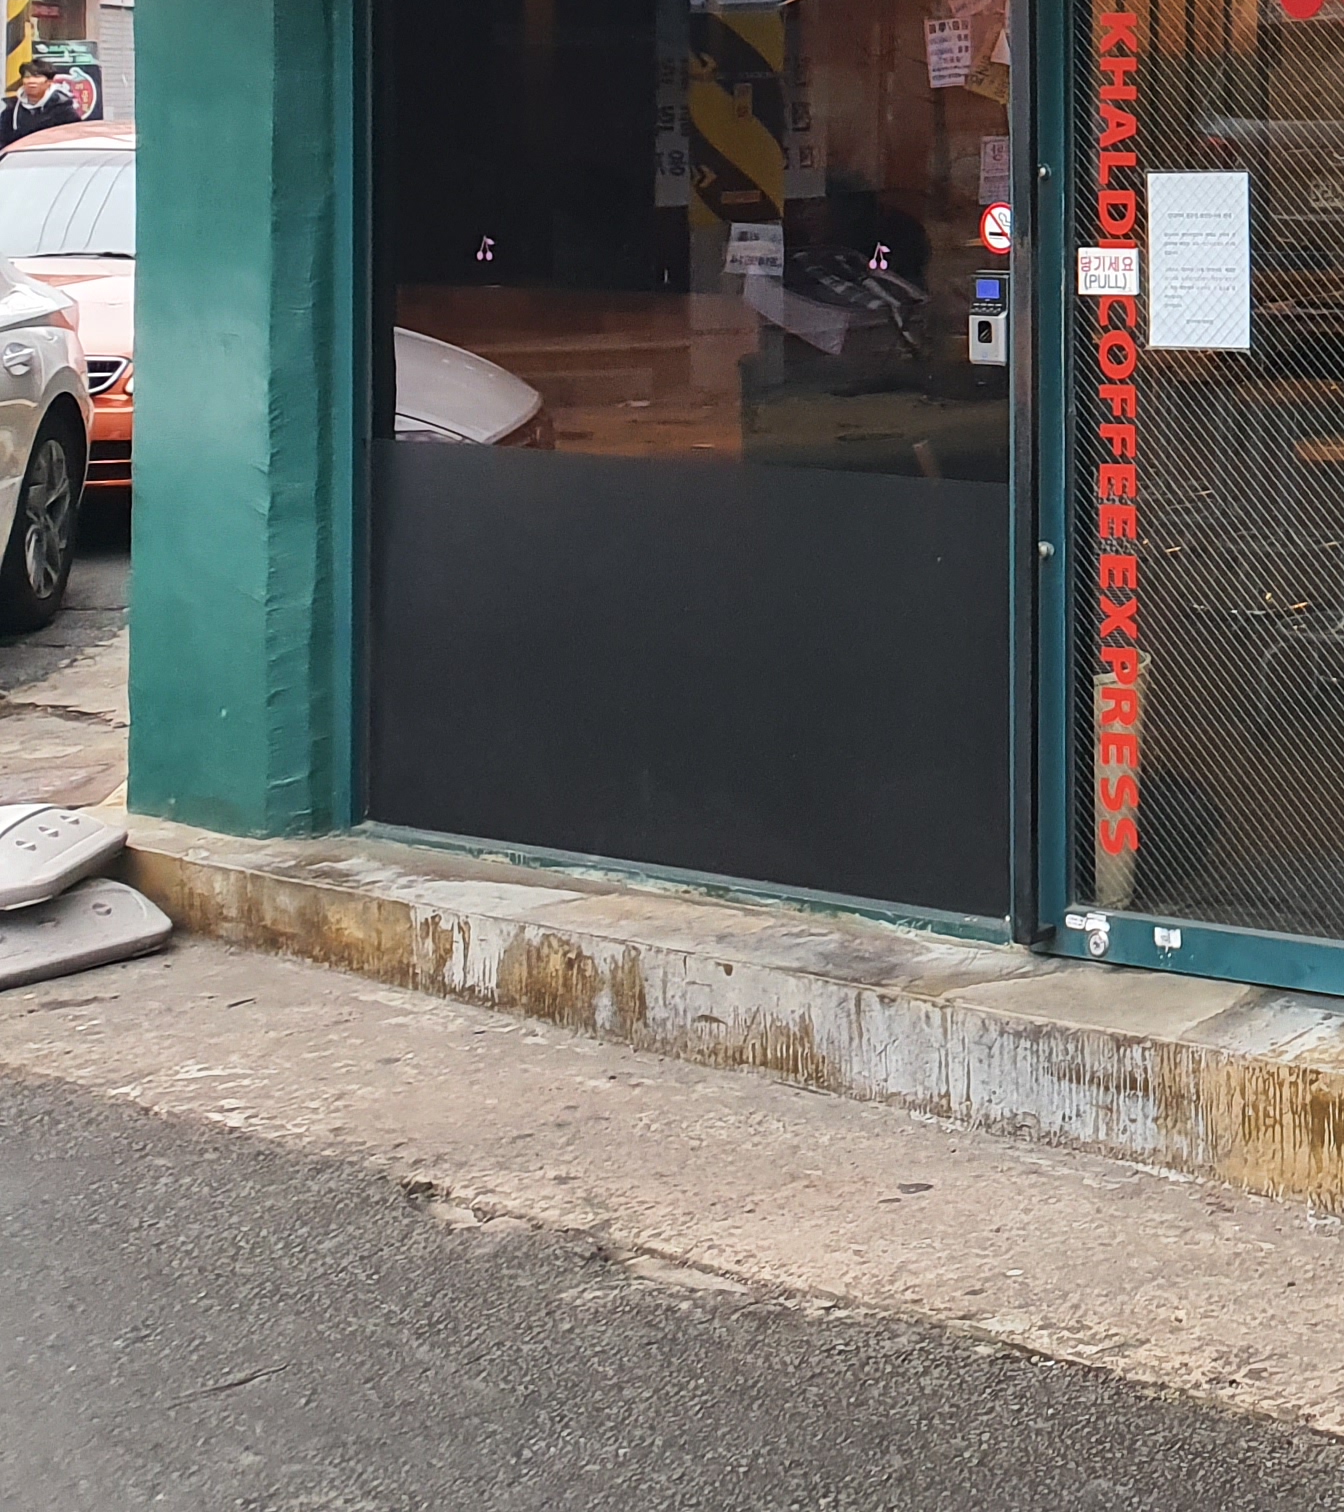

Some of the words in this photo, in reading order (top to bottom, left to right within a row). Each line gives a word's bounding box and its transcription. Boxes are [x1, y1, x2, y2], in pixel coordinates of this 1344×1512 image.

[1098, 12, 1138, 248] KHALDI
[1080, 255, 1134, 272] 당기세요
[1084, 273, 1127, 290] (PULL)
[1097, 294, 1137, 539] COFFEE
[1099, 554, 1140, 856] EXPRESS
